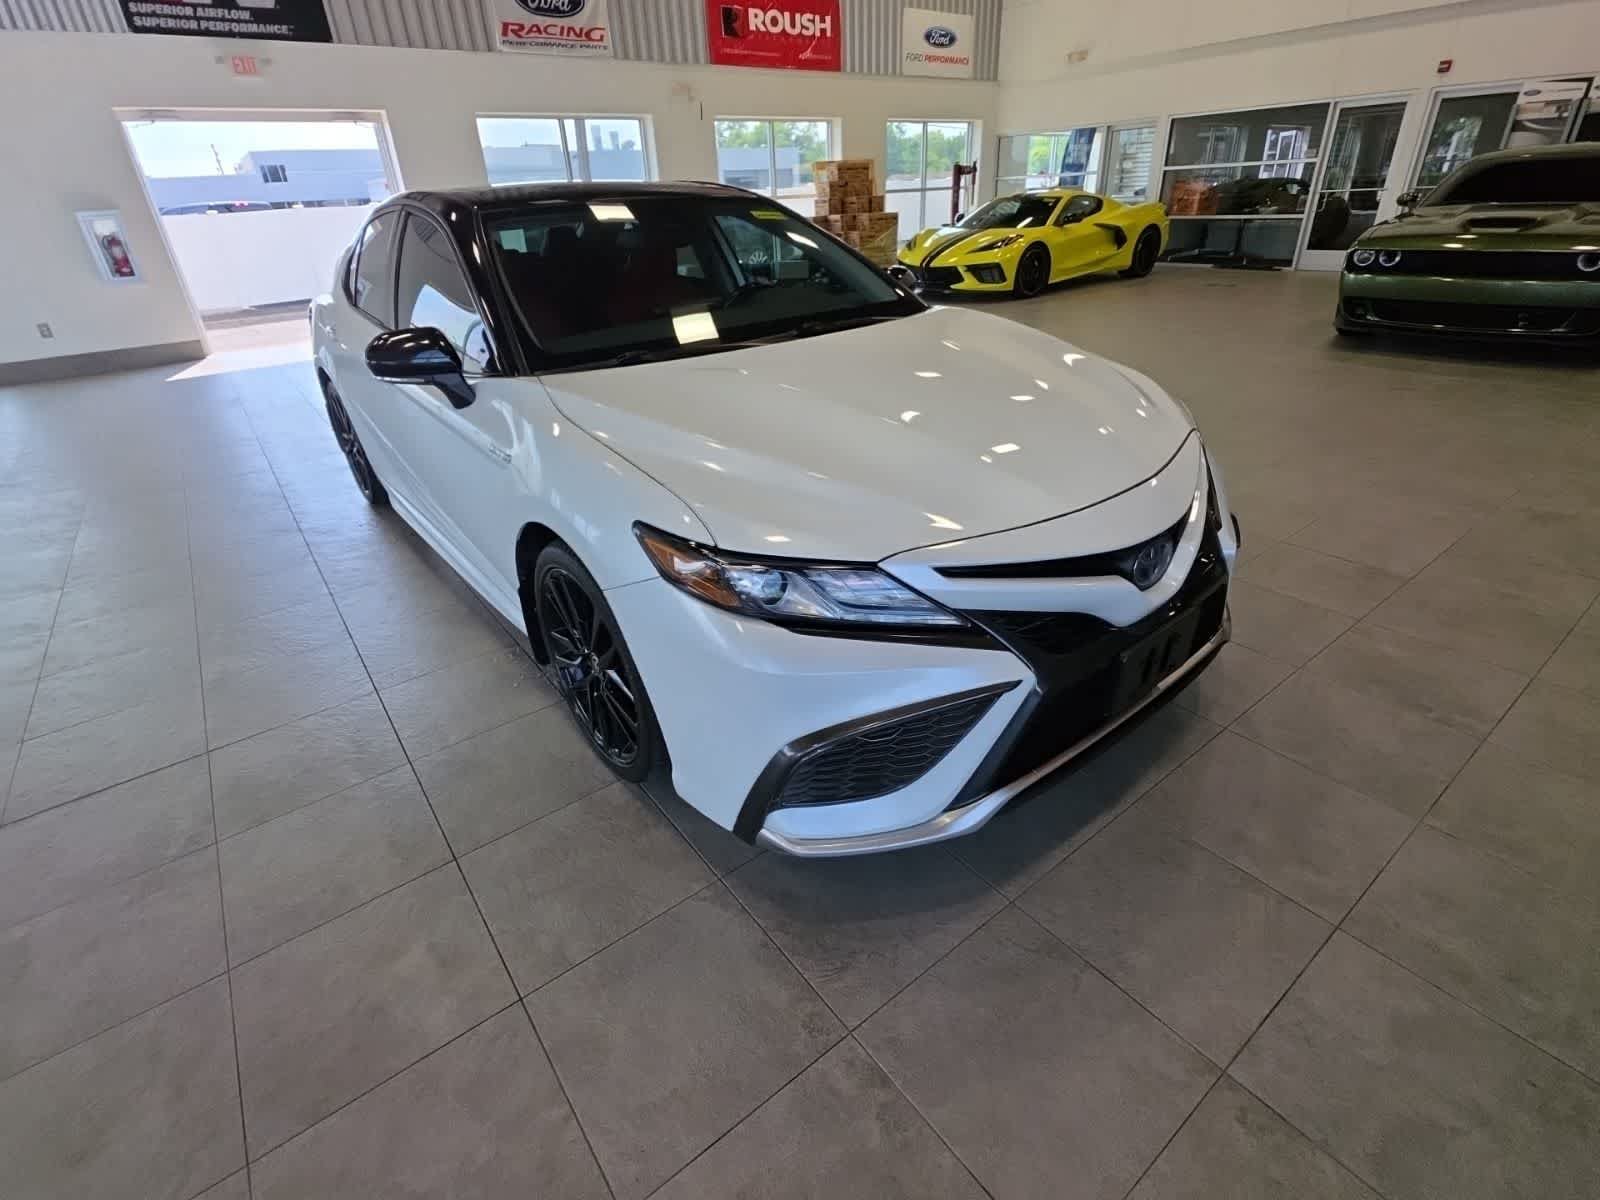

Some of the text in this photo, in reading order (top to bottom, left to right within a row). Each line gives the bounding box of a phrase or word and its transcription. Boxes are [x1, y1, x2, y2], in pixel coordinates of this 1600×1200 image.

[128, 2, 254, 20] SUPERIOR AIRFLOW.
[133, 15, 198, 30] SUPERIOR
[748, 7, 832, 37] ROUSH
[501, 21, 606, 42] RACING
[929, 30, 950, 45] Ford
